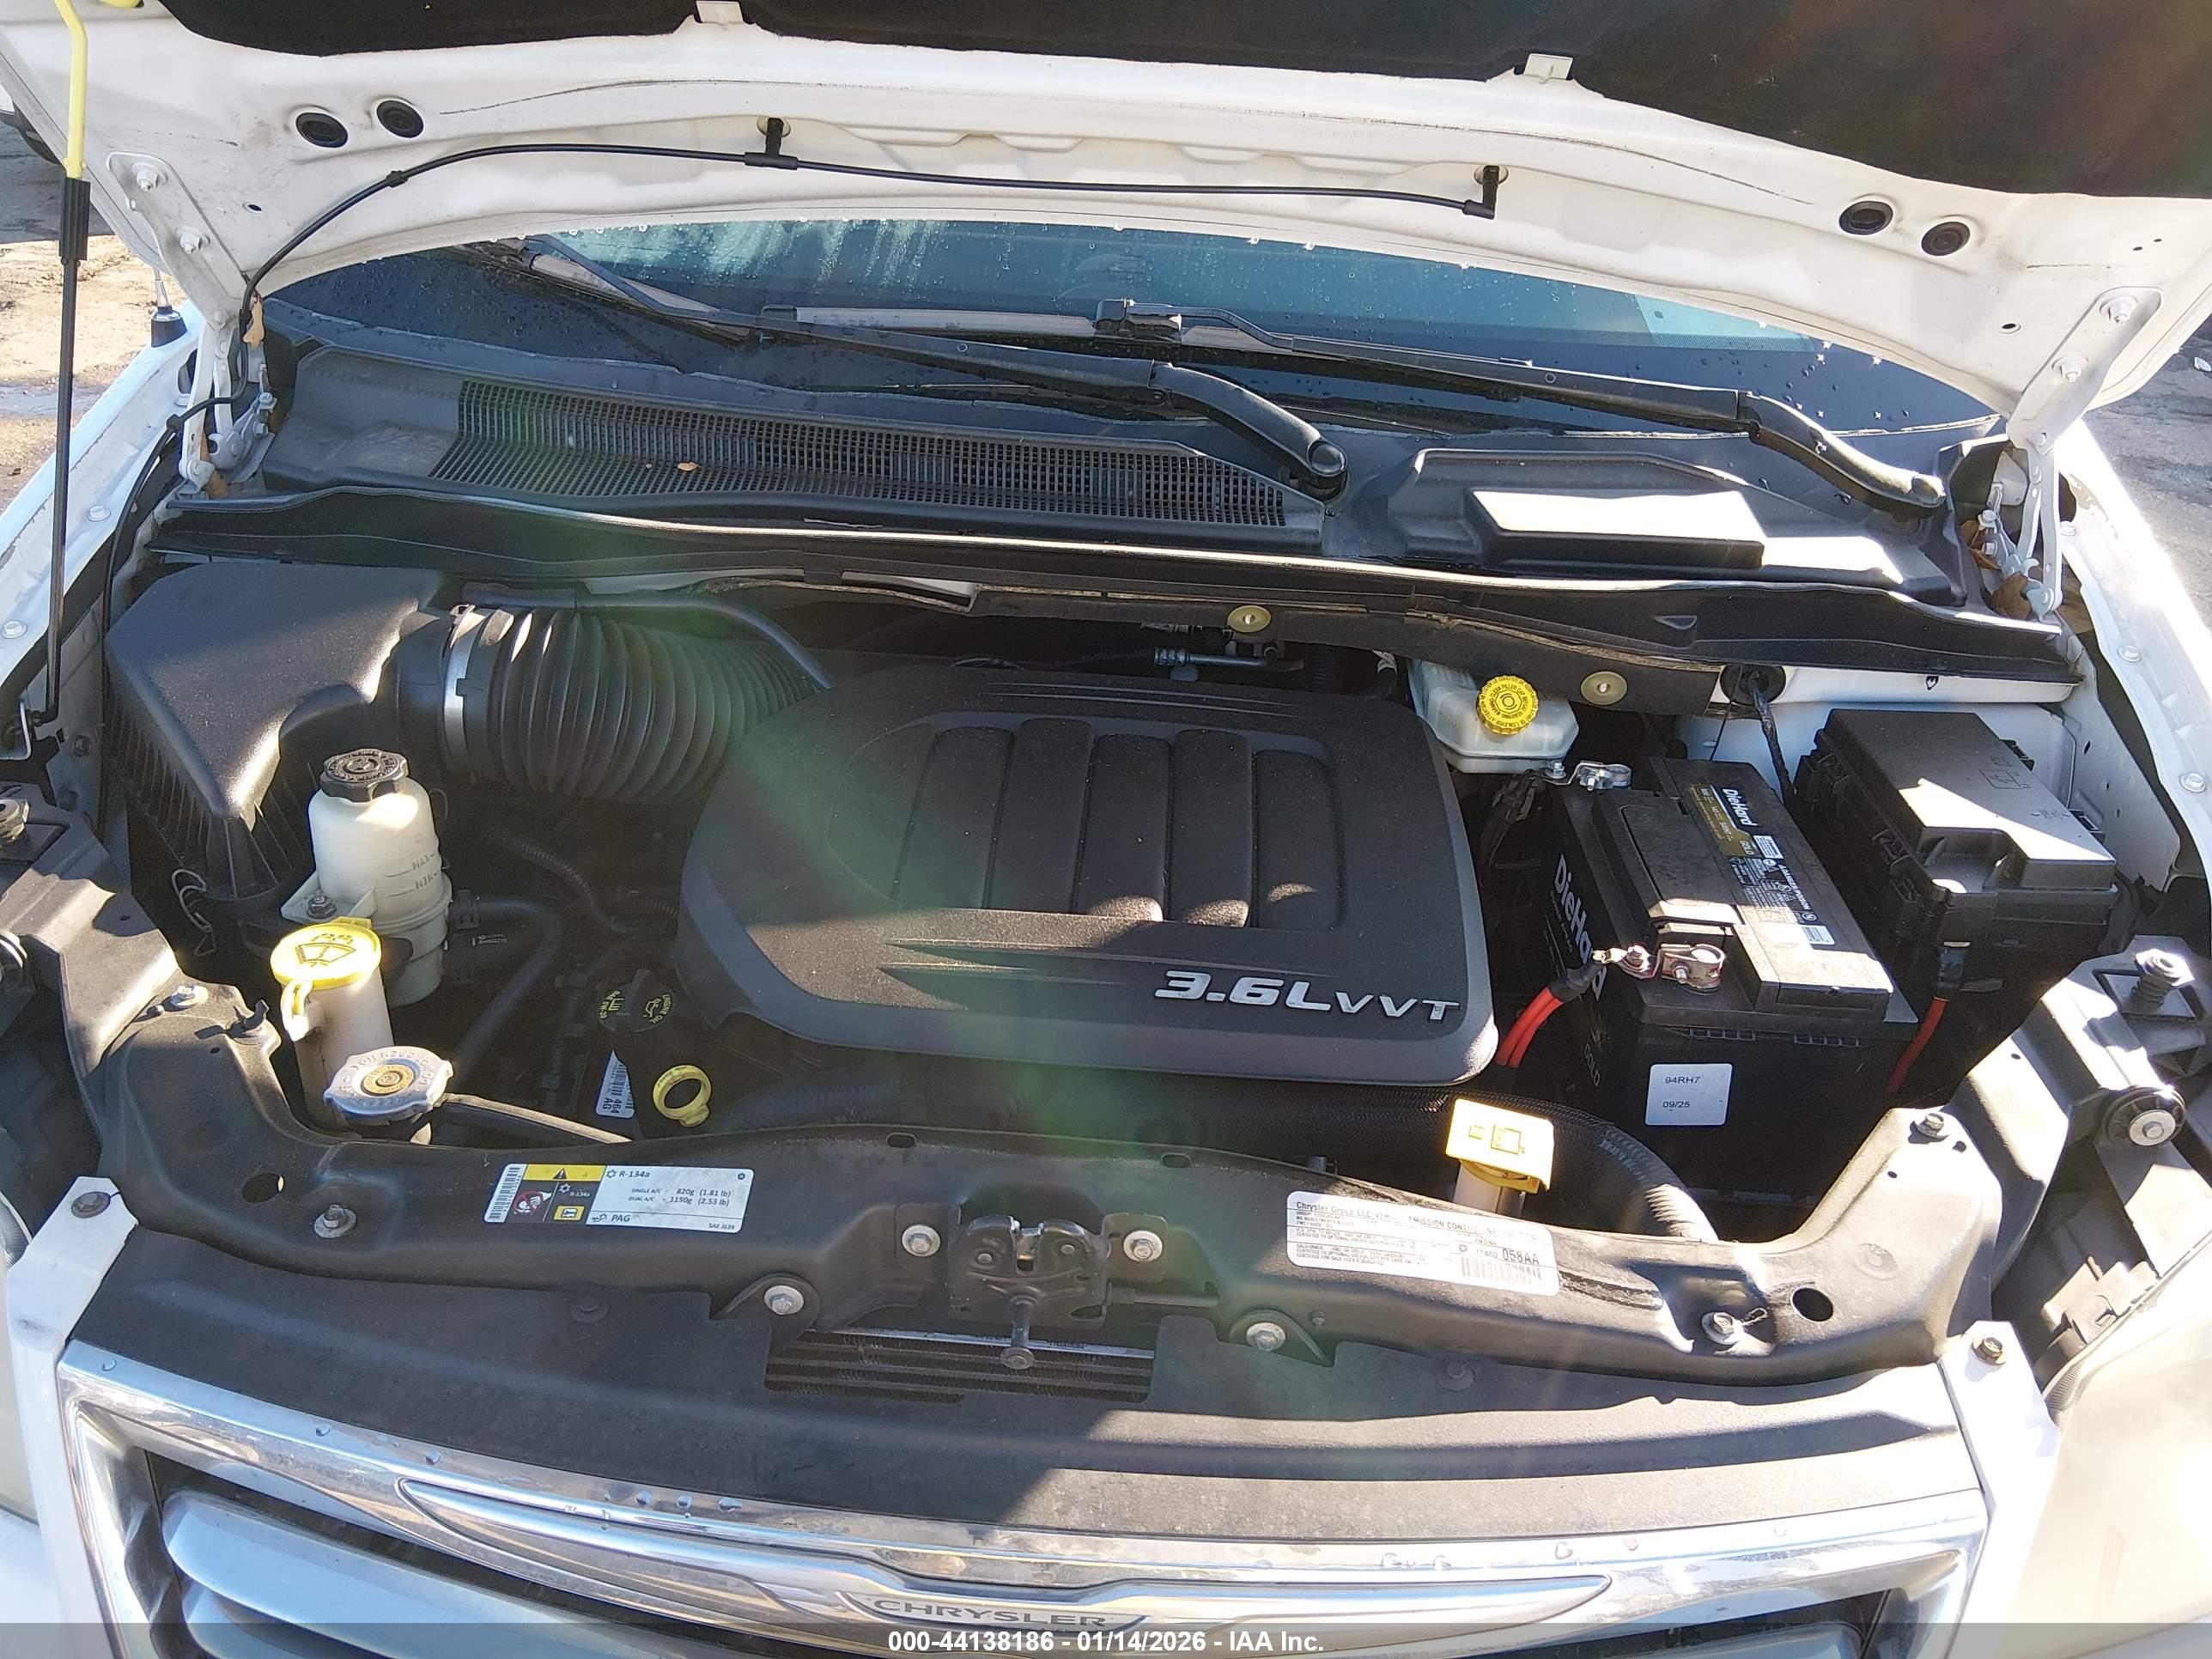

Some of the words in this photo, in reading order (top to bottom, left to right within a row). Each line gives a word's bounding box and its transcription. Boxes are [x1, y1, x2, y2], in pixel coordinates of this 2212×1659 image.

[1723, 787, 1759, 827] DieHard
[1740, 840, 1754, 855] GOLD
[1554, 853, 1607, 1002] DieHad
[1154, 970, 1332, 1012] 3.6L
[1335, 991, 1460, 1021] VVT
[660, 994, 672, 1015] ENGINE
[648, 1015, 663, 1024] OIL
[1664, 1075, 1700, 1084] 94RH7
[603, 1097, 613, 1110] AG
[611, 1098, 623, 1114] 464
[1662, 1100, 1690, 1109] 09/25
[676, 1188, 695, 1196] 820g
[720, 1189, 732, 1198] lb)
[670, 1196, 693, 1205] 1150g
[719, 1198, 730, 1207] lb)
[1296, 1200, 1328, 1212] Chrysler
[1331, 1206, 1354, 1217] Group
[1357, 1209, 1372, 1218] LLC
[1408, 1215, 1444, 1229] EMISSION
[1502, 1248, 1540, 1265] 058AA
[873, 1599, 1107, 1628] CHRYSLER
